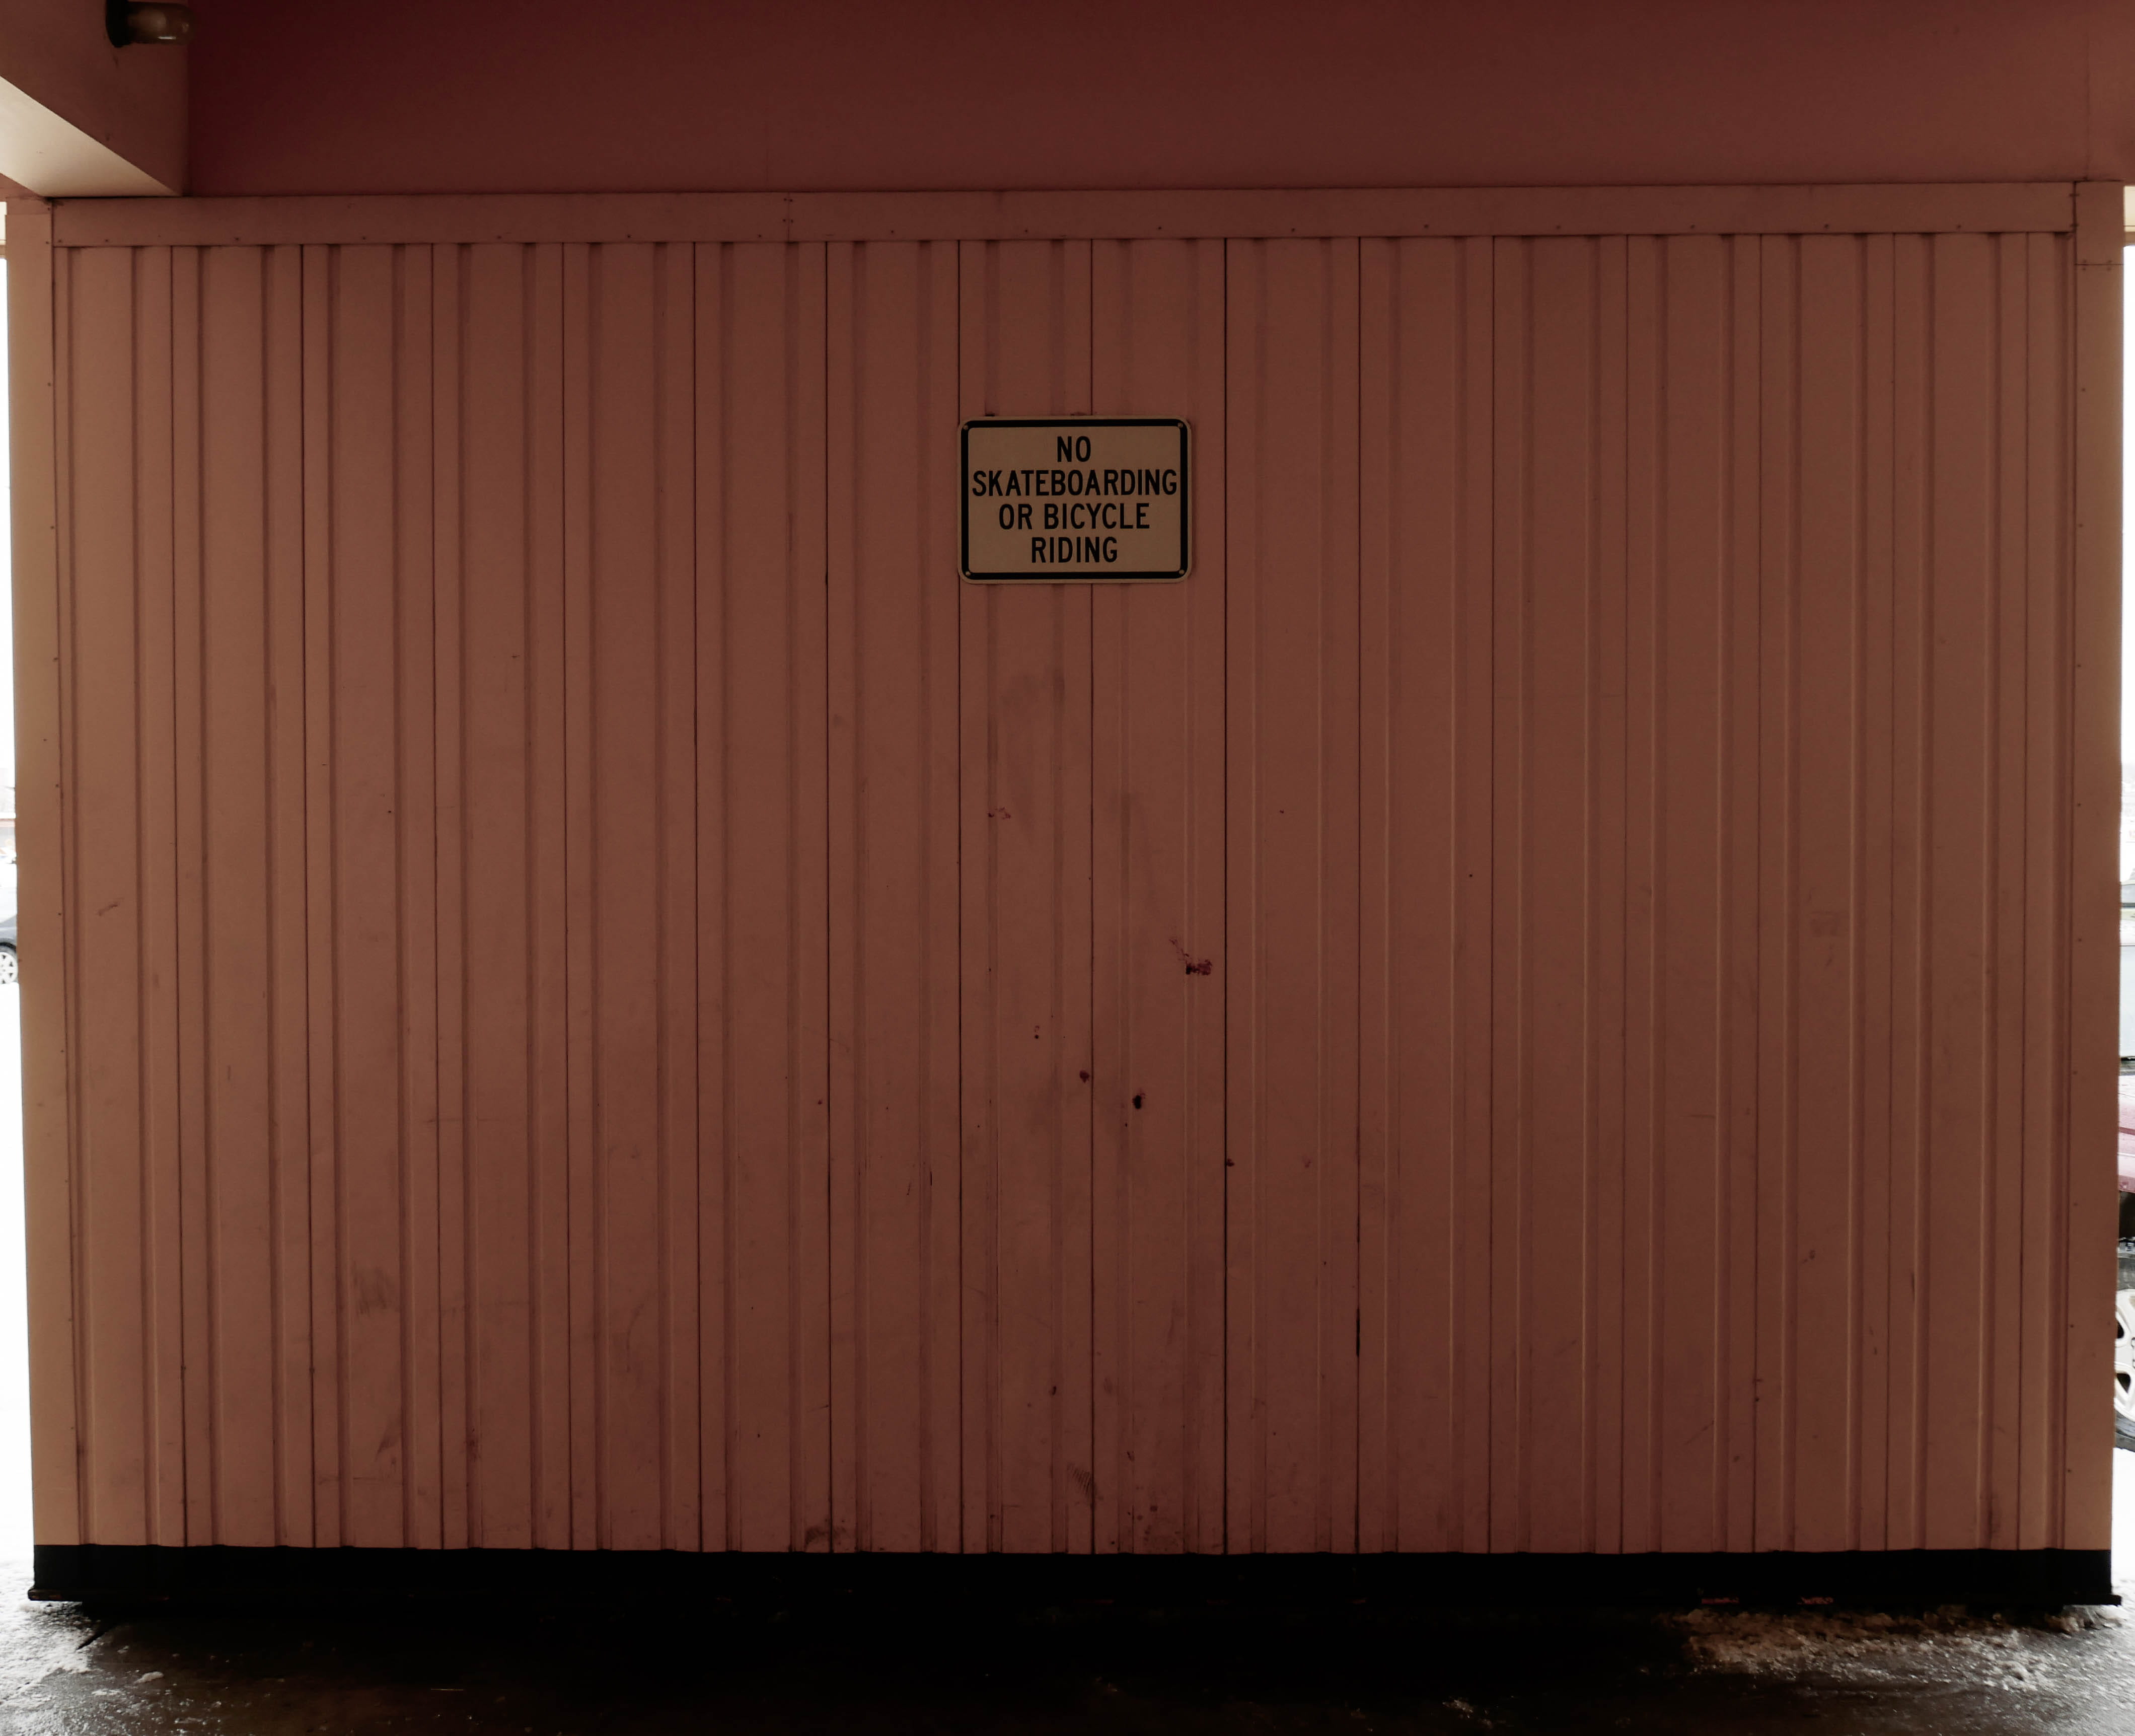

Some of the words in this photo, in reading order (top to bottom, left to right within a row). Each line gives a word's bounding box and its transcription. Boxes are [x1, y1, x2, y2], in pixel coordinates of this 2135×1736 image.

[1057, 436, 1091, 463] NO
[972, 469, 1177, 497] SKATEBOARDING
[999, 503, 1033, 530] OR
[1044, 502, 1150, 530] BICYCLE
[1031, 536, 1118, 563] RIDING
